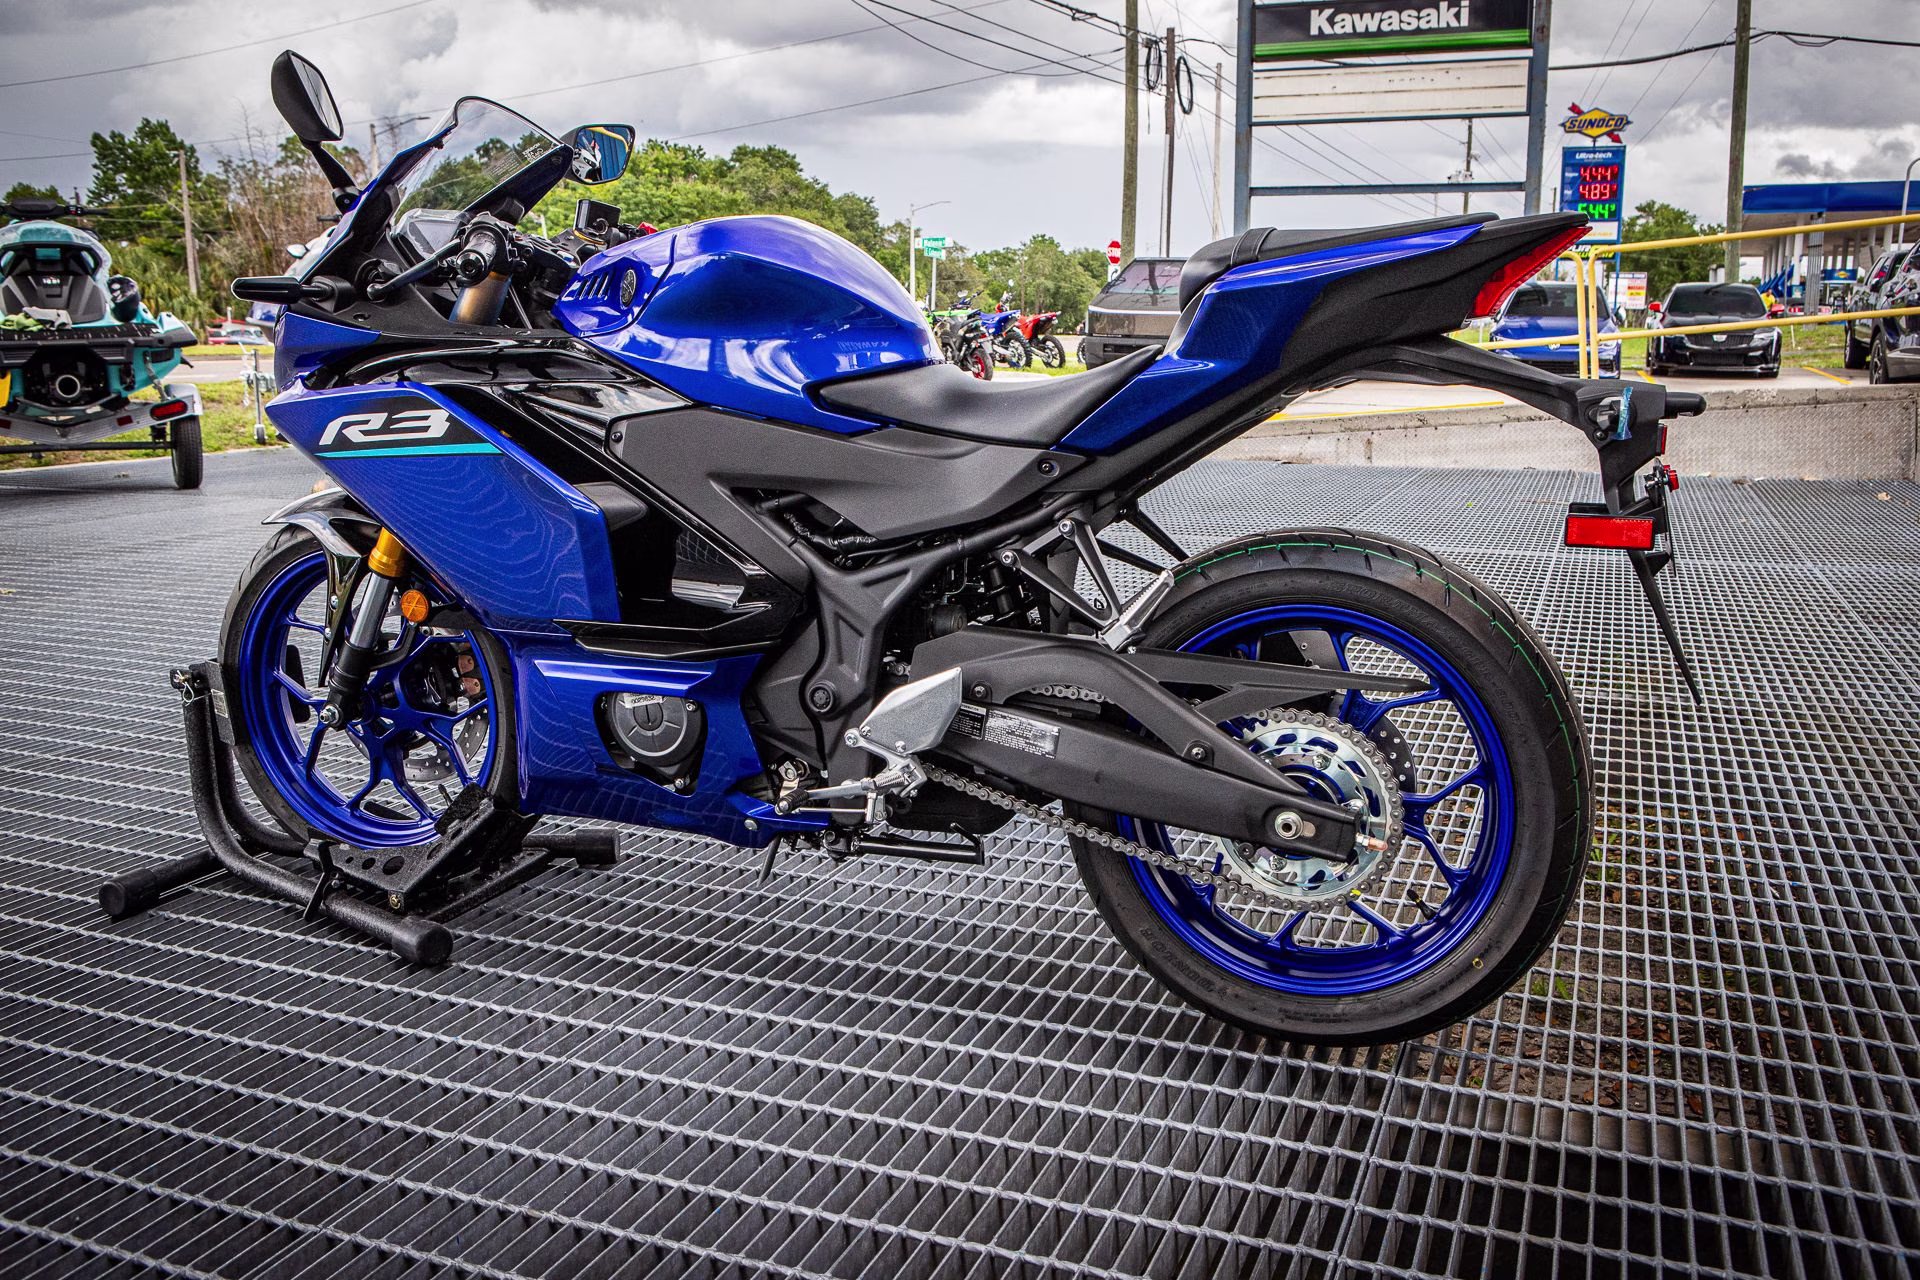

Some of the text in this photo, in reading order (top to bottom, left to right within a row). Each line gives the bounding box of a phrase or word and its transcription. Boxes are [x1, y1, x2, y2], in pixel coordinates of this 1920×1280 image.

[1310, 0, 1470, 36] Kawasaki
[1567, 117, 1624, 129] SUNOCO
[319, 408, 450, 446] R3
